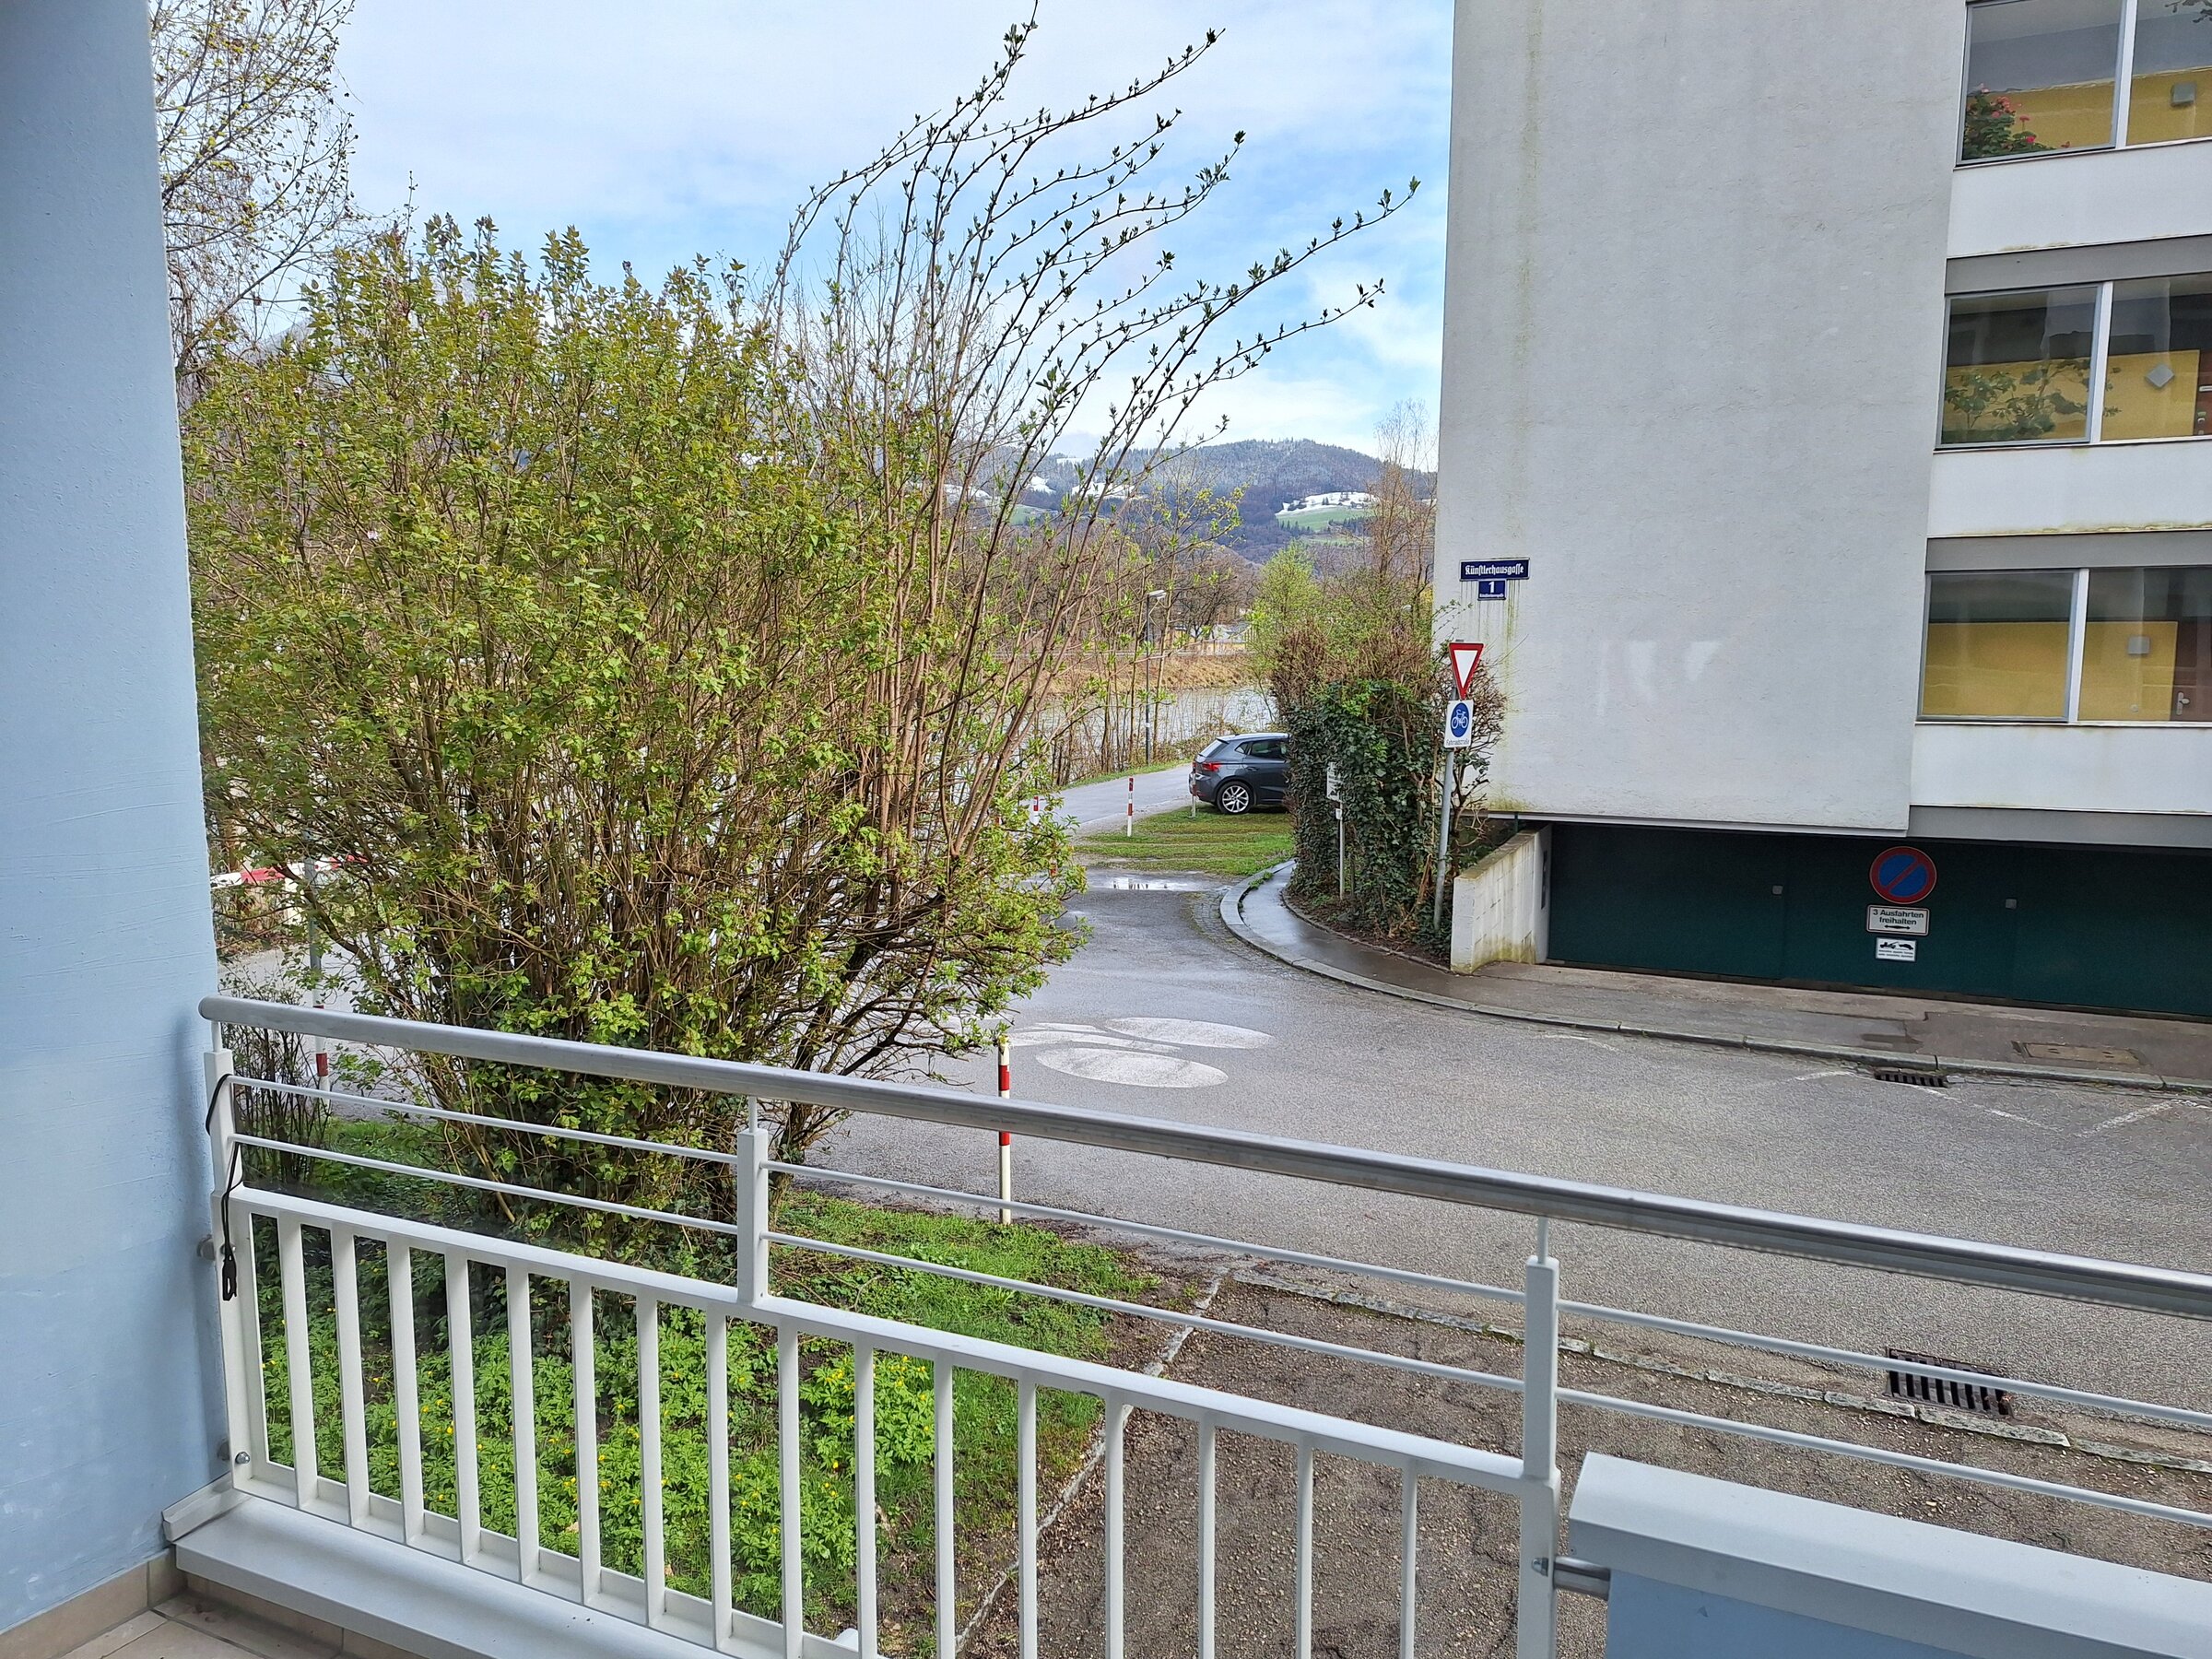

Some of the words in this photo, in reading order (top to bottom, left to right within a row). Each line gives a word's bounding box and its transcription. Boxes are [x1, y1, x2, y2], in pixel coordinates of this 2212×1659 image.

[1488, 581, 1495, 594] 1
[1880, 909, 1924, 919] Ausfahrten
[1879, 917, 1917, 925] freihalten
